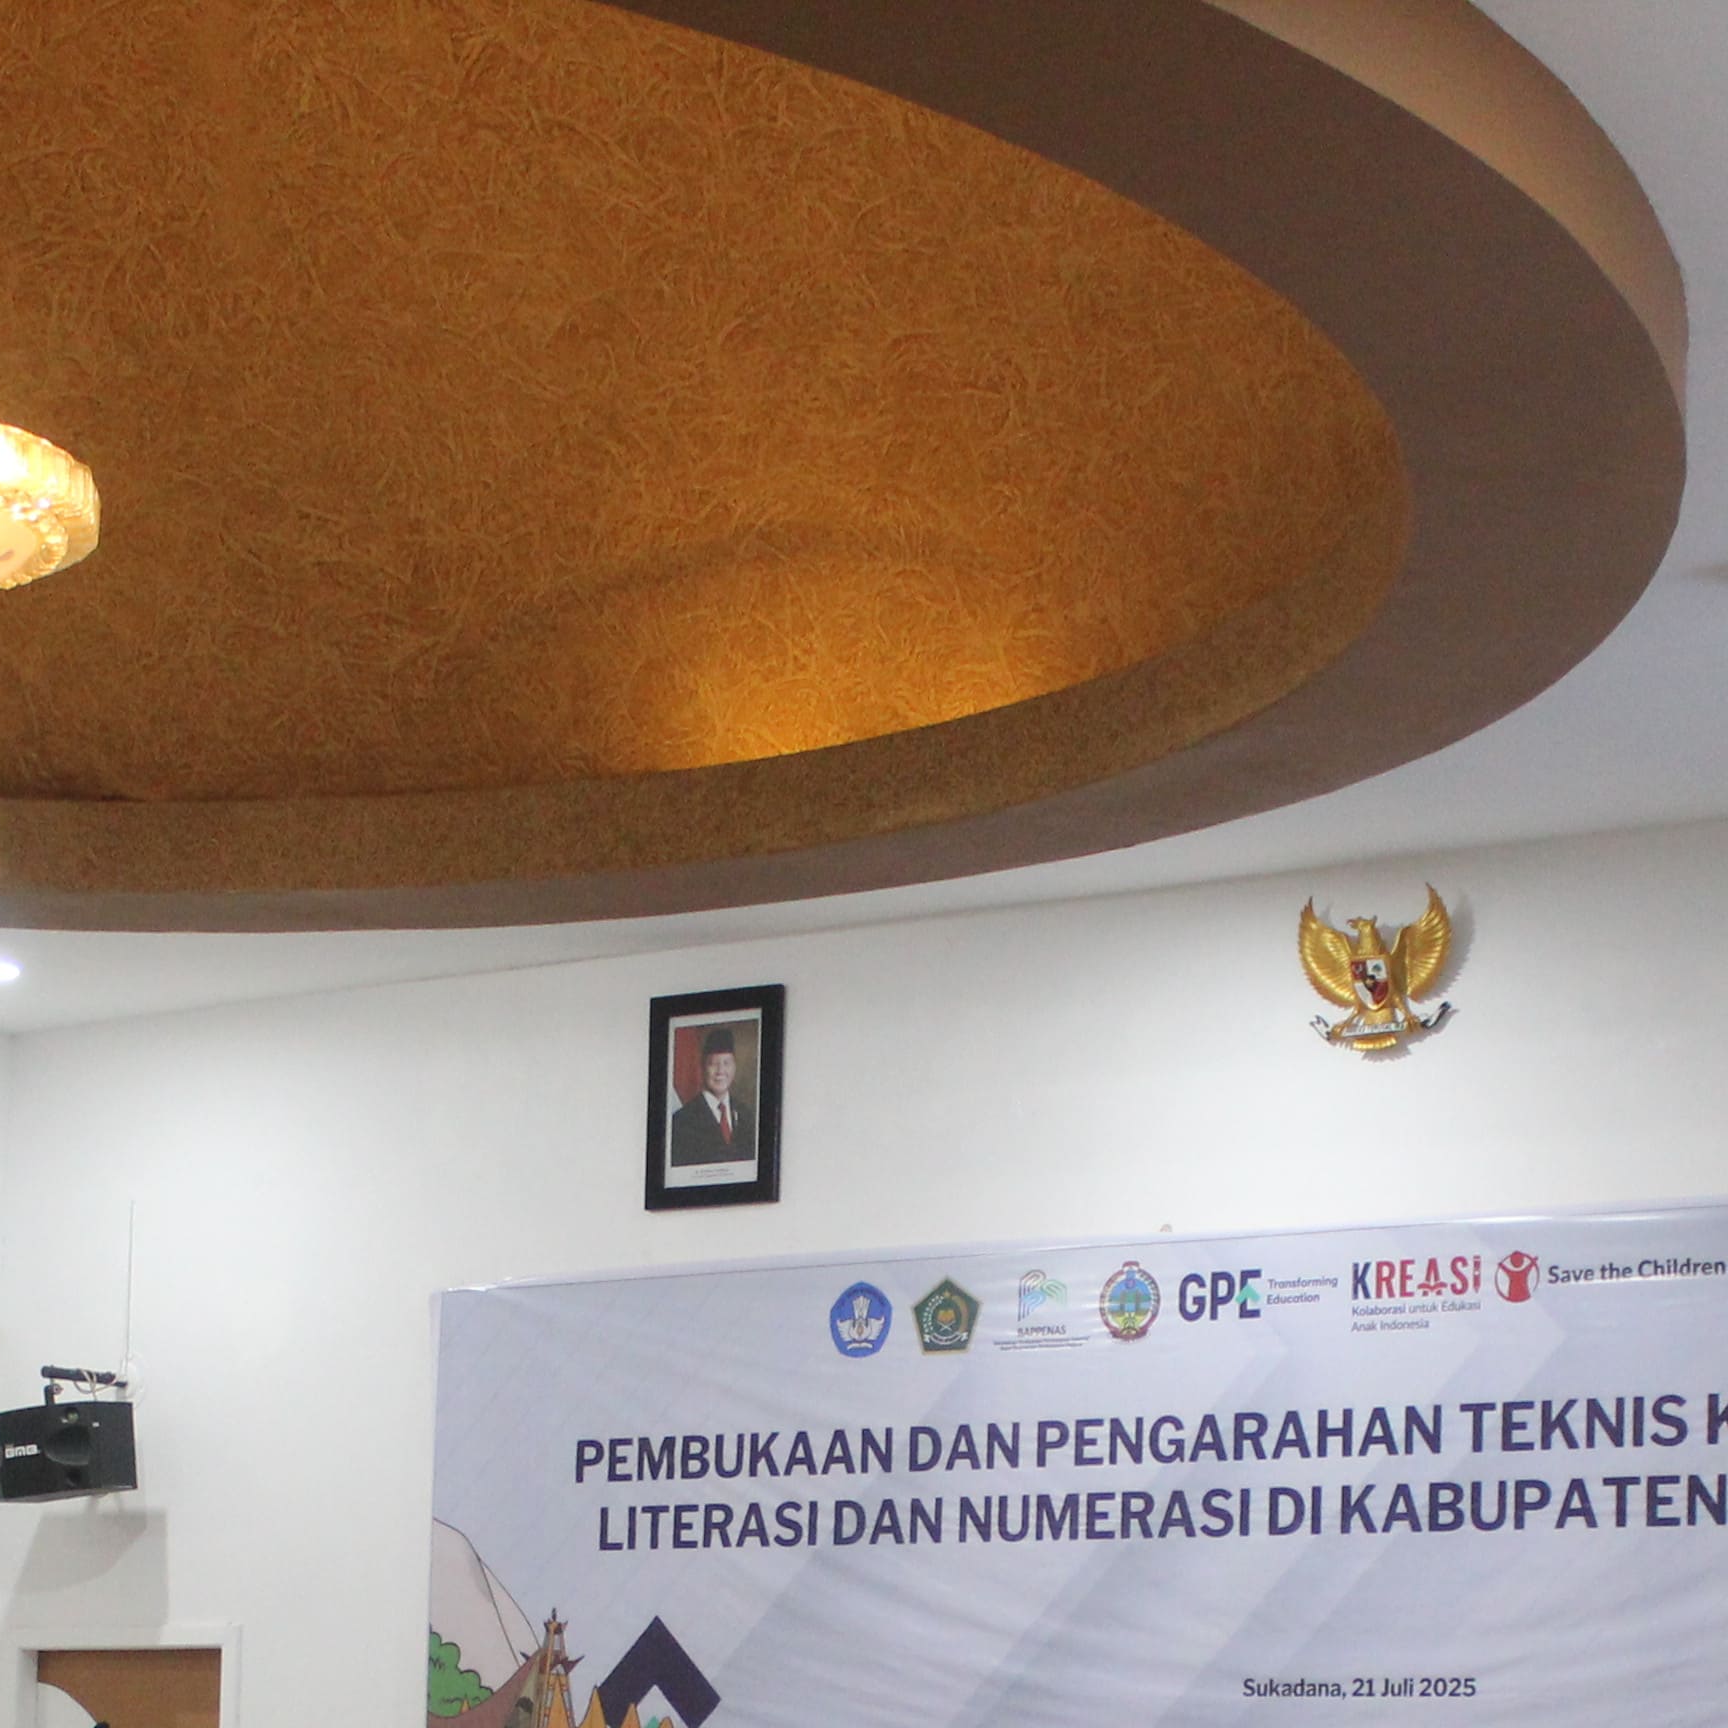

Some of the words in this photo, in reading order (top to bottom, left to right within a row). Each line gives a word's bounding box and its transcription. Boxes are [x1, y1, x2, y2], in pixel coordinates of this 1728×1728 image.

[1267, 1275, 1338, 1290] Transforming
[1547, 1264, 1595, 1284] Save
[1600, 1261, 1633, 1280] the
[1637, 1258, 1727, 1278] Children
[1178, 1268, 1262, 1322] GPE
[1266, 1292, 1321, 1305] Education
[1351, 1303, 1406, 1317] Kolaborasi
[1408, 1302, 1438, 1315] untuk
[1441, 1300, 1481, 1312] Edukasi
[1351, 1319, 1377, 1332] Anak
[1379, 1318, 1430, 1331] Indonesia
[575, 1427, 893, 1483] PEMBUKAAN
[908, 1422, 1020, 1472] DAN
[1036, 1404, 1442, 1468] PENGARAHAN
[1460, 1394, 1688, 1452] TEKNIS
[598, 1500, 818, 1551] LITERASI
[833, 1496, 943, 1546] DAN
[958, 1488, 1251, 1543] NUMERASI
[1268, 1485, 1322, 1536] DI
[1339, 1473, 1728, 1534] KABUPATEN
[1242, 1678, 1347, 1700] Sukadana,
[1352, 1679, 1375, 1697] 21
[1380, 1677, 1414, 1698] Juli
[1419, 1678, 1477, 1698] 2025
